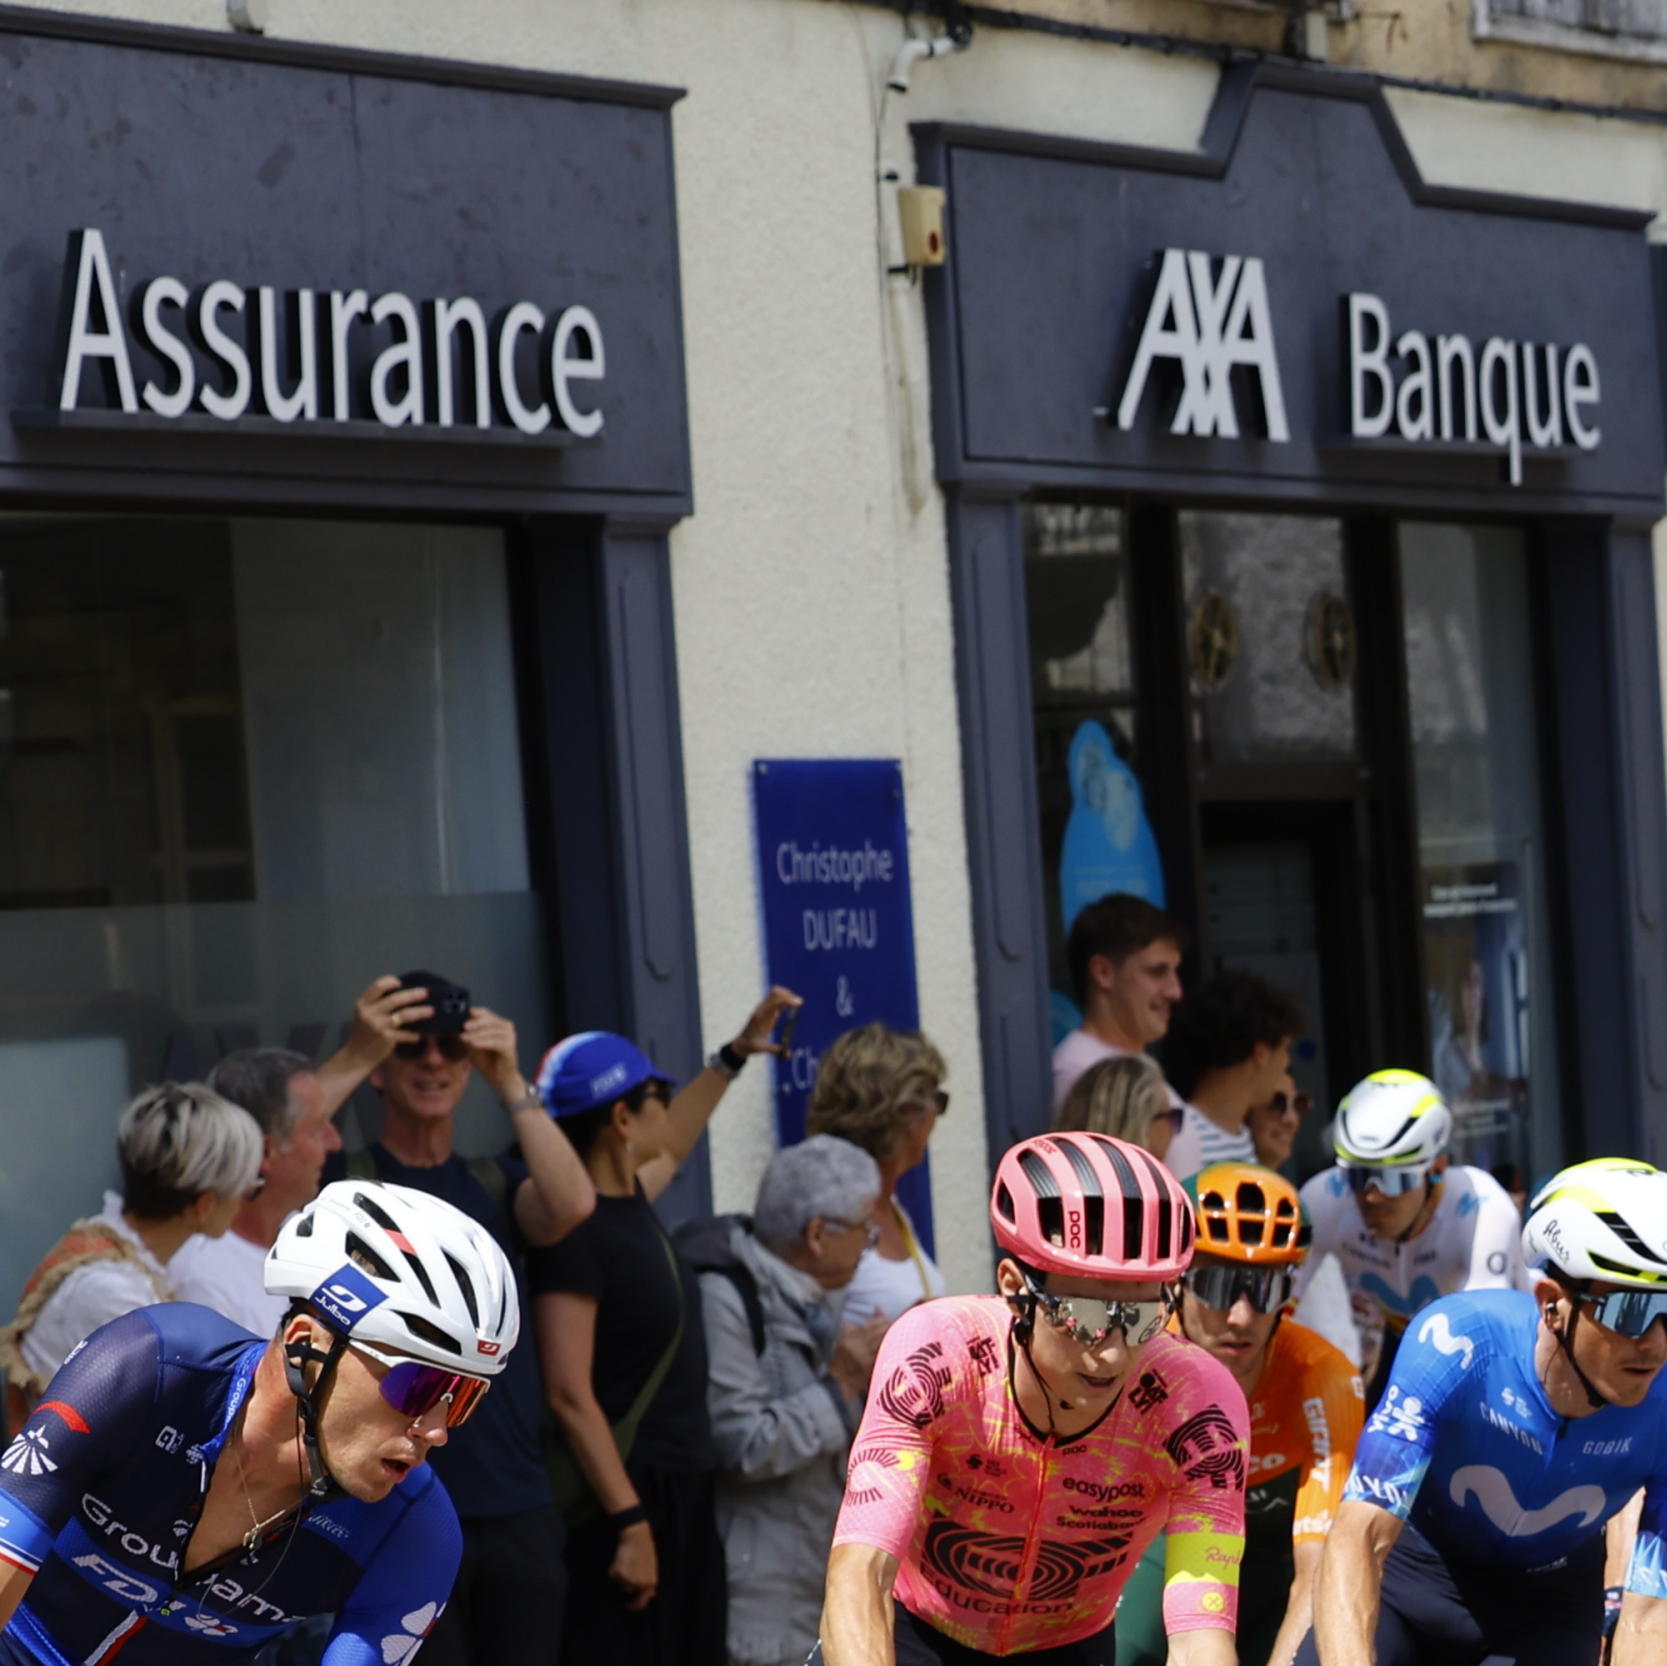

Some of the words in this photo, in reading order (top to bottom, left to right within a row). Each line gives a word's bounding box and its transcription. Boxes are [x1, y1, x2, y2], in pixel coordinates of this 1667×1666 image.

[60, 228, 606, 438] Assurance
[1117, 248, 1290, 443] AXA
[1347, 291, 1601, 487] Banque
[776, 840, 895, 893] Christophe
[803, 908, 878, 951] DUFAU
[835, 974, 855, 1018] &
[1480, 1402, 1545, 1456] CANYON
[955, 1487, 1016, 1514] NIPPO
[1062, 1475, 1145, 1502] easypost
[71, 1553, 160, 1612] FD
[1204, 1546, 1242, 1570] Raph
